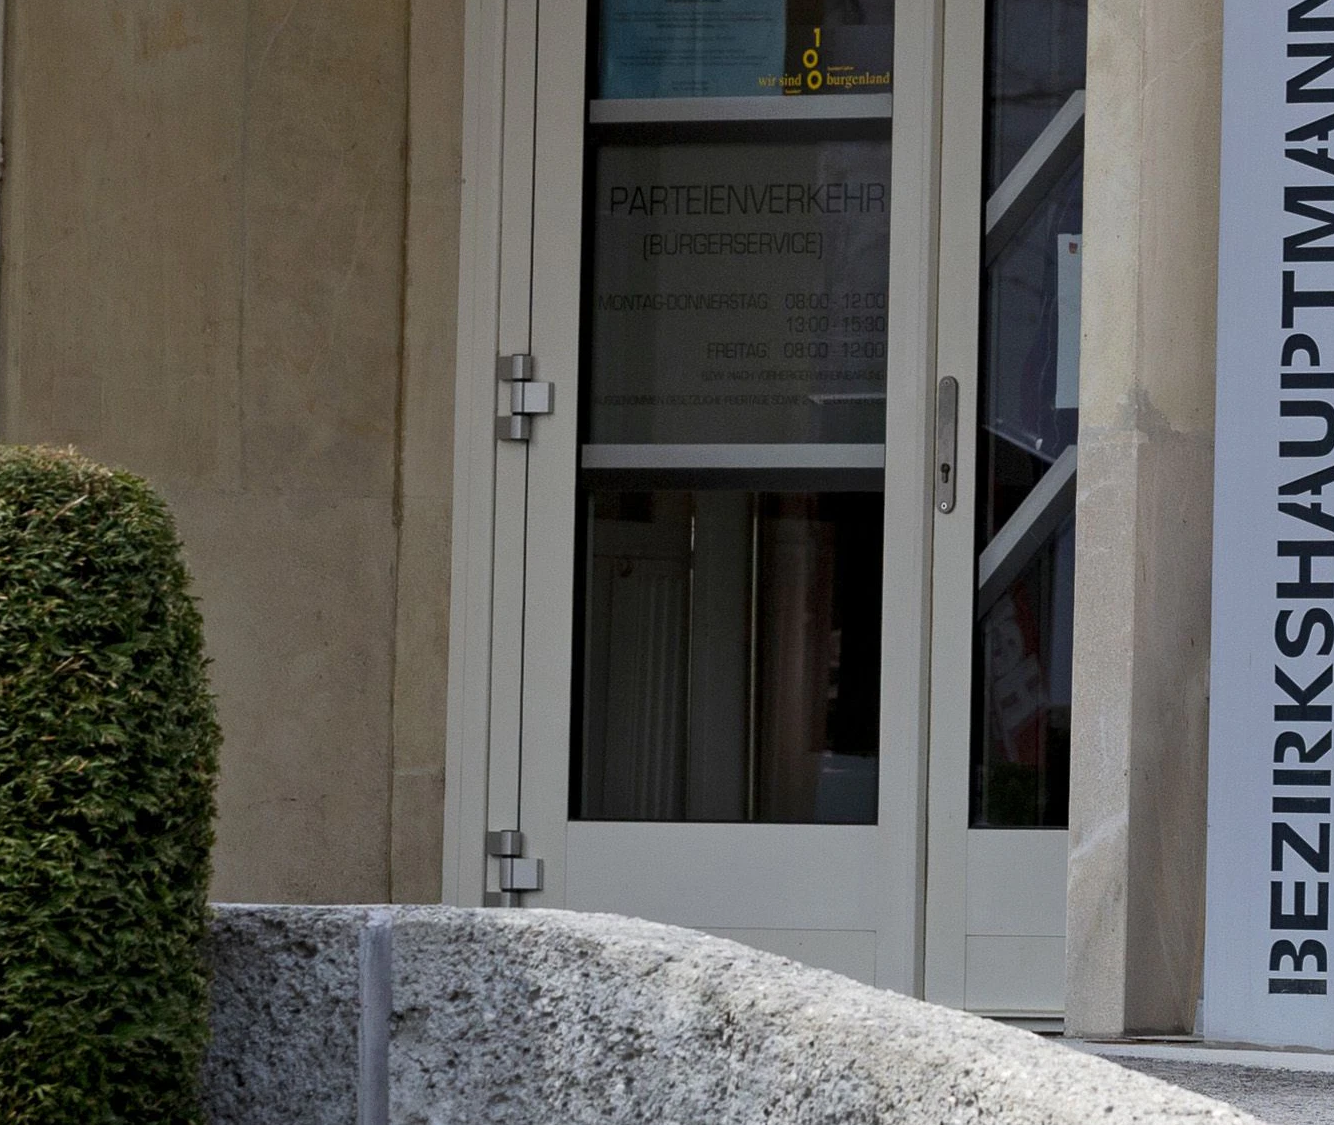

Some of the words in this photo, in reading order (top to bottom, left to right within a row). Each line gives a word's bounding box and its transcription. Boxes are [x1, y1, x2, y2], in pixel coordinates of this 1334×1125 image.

[758, 73, 776, 88] wir
[778, 72, 803, 87] sind
[826, 71, 890, 89] burgenland
[609, 183, 886, 216] PARTEIENVERKEHR
[785, 293, 829, 310] 08:00
[783, 341, 829, 359] 08:00
